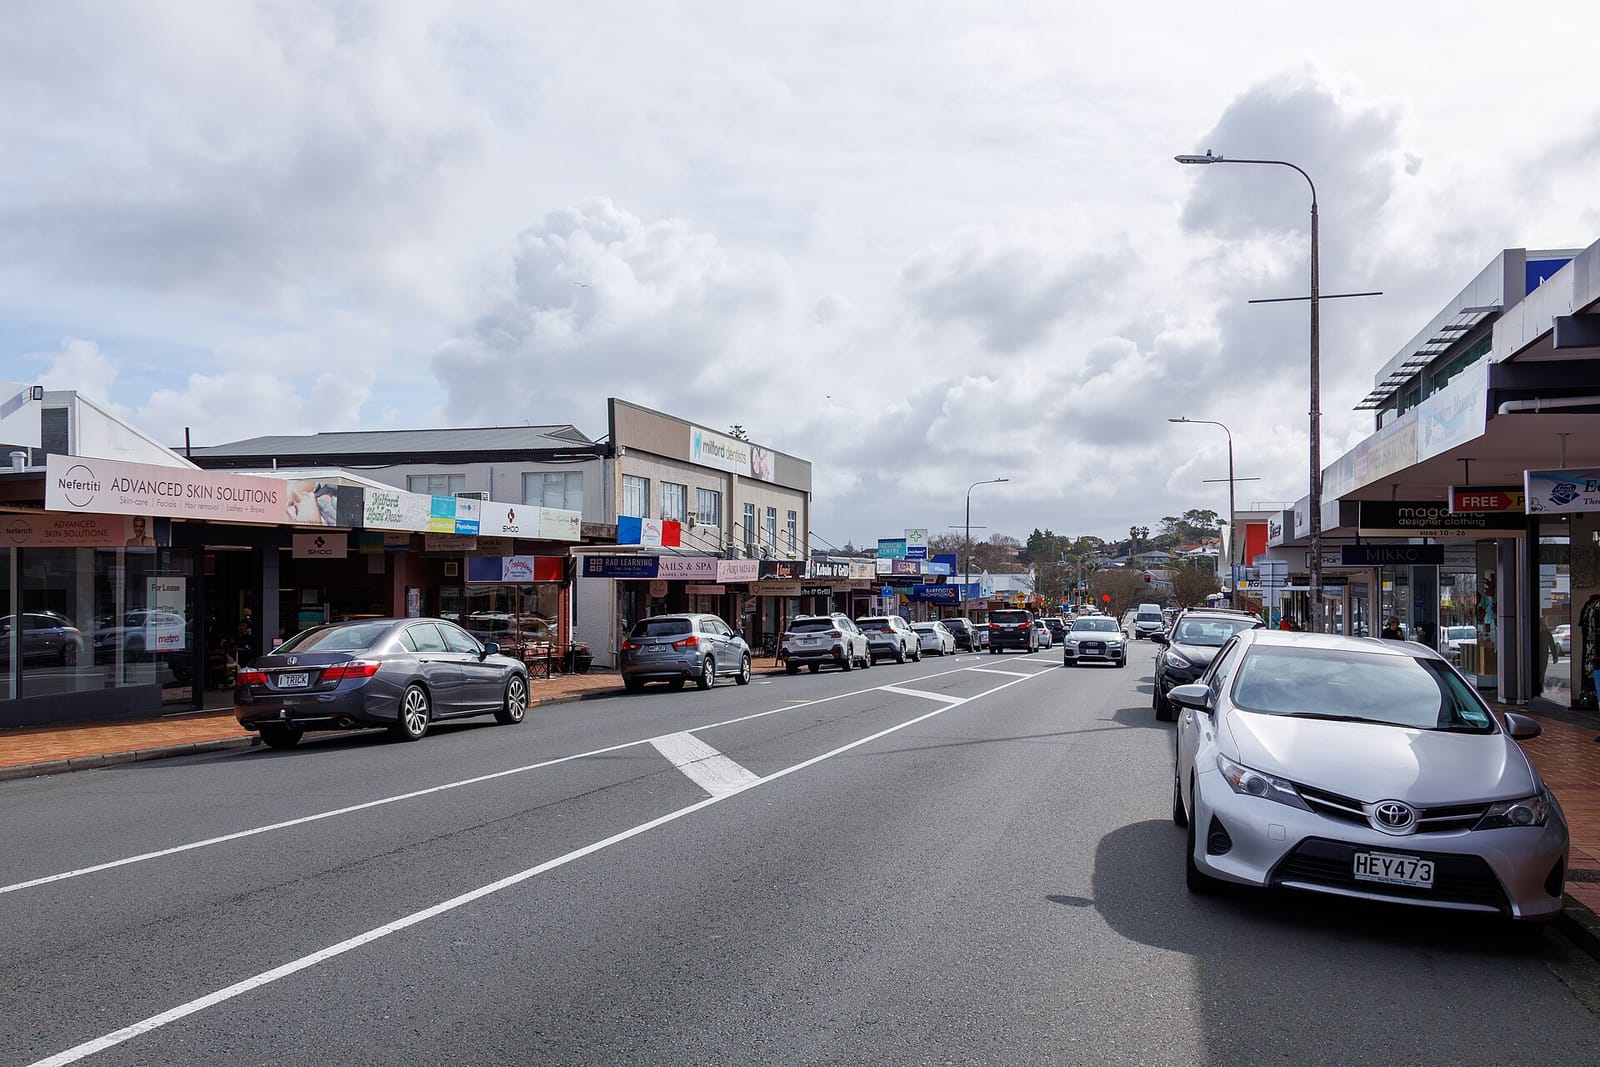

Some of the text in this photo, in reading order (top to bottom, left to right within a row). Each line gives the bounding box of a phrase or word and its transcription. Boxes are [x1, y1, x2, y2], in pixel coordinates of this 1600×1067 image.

[702, 440, 748, 465] milford dentists
[58, 478, 101, 492] Nefertiti
[110, 477, 278, 504] ADVANCED SKIN SOLUTIONS
[119, 495, 149, 507] Skin-care
[156, 498, 177, 508] Facials
[184, 501, 220, 511] Hair removal
[1462, 496, 1499, 507] FREE
[53, 520, 96, 529] ADVANCED
[1398, 518, 1486, 527] designer clothing
[44, 529, 109, 538] SKIN SOLUTIONS
[1366, 548, 1418, 561] MIKKO
[620, 557, 653, 567] LEARNING
[659, 562, 684, 571] NAILS
[686, 562, 693, 571] &
[695, 562, 712, 571] SPA
[151, 584, 181, 592] For Lease
[158, 634, 180, 643] metro
[1356, 855, 1432, 882] HEY473
